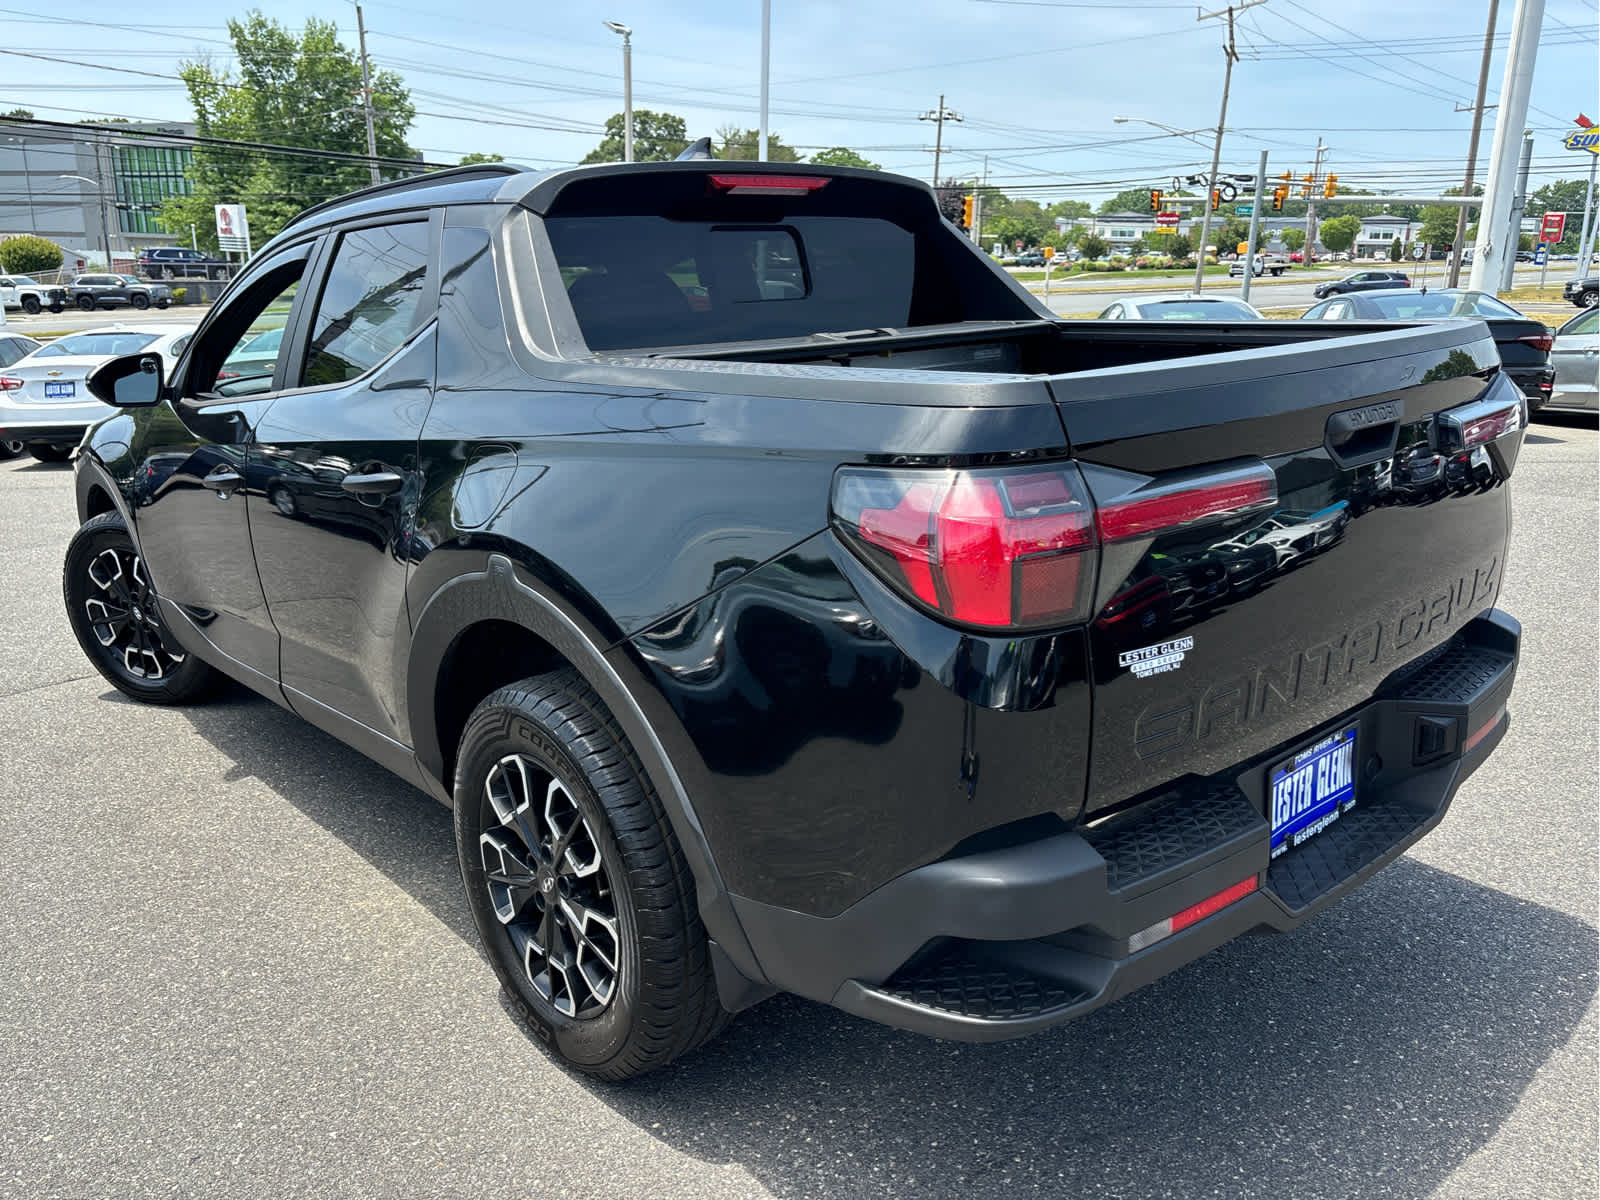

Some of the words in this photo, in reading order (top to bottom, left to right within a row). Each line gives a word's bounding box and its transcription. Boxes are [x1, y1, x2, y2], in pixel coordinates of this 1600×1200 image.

[1119, 648, 1159, 665] LESTER
[1160, 637, 1194, 654] GLENN
[1271, 764, 1313, 832] LESTER
[1316, 740, 1354, 801] GLENN
